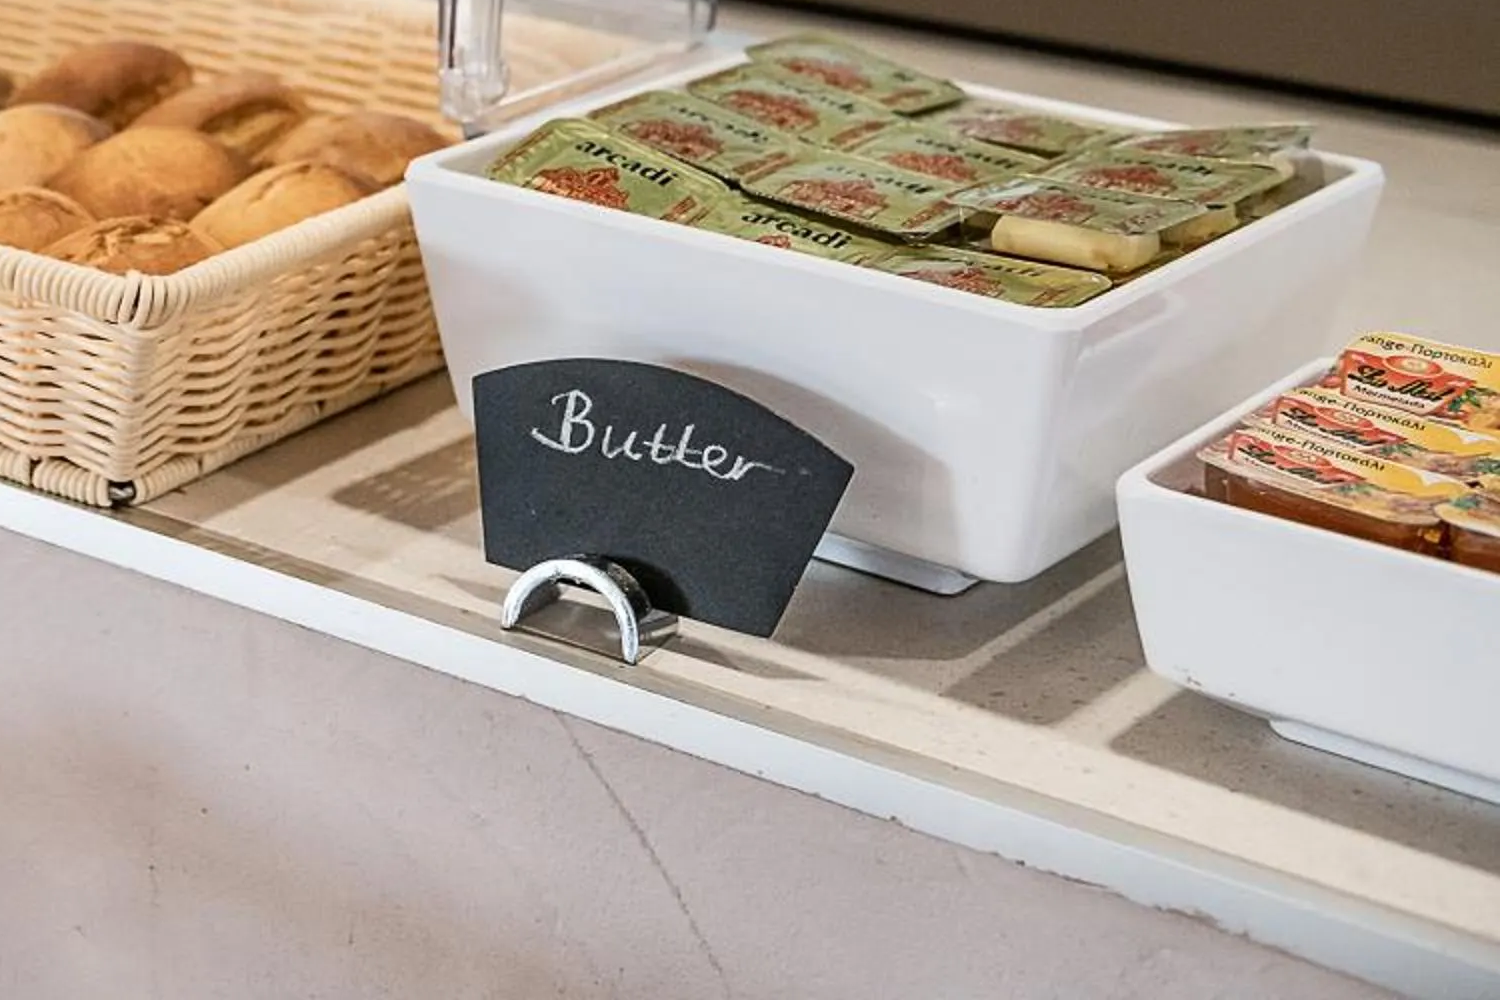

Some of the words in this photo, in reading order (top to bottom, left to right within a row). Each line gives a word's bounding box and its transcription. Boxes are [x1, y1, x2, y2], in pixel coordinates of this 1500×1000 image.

[575, 140, 679, 187] arcadi
[741, 211, 853, 250] arcadi
[531, 389, 786, 480] Butter
